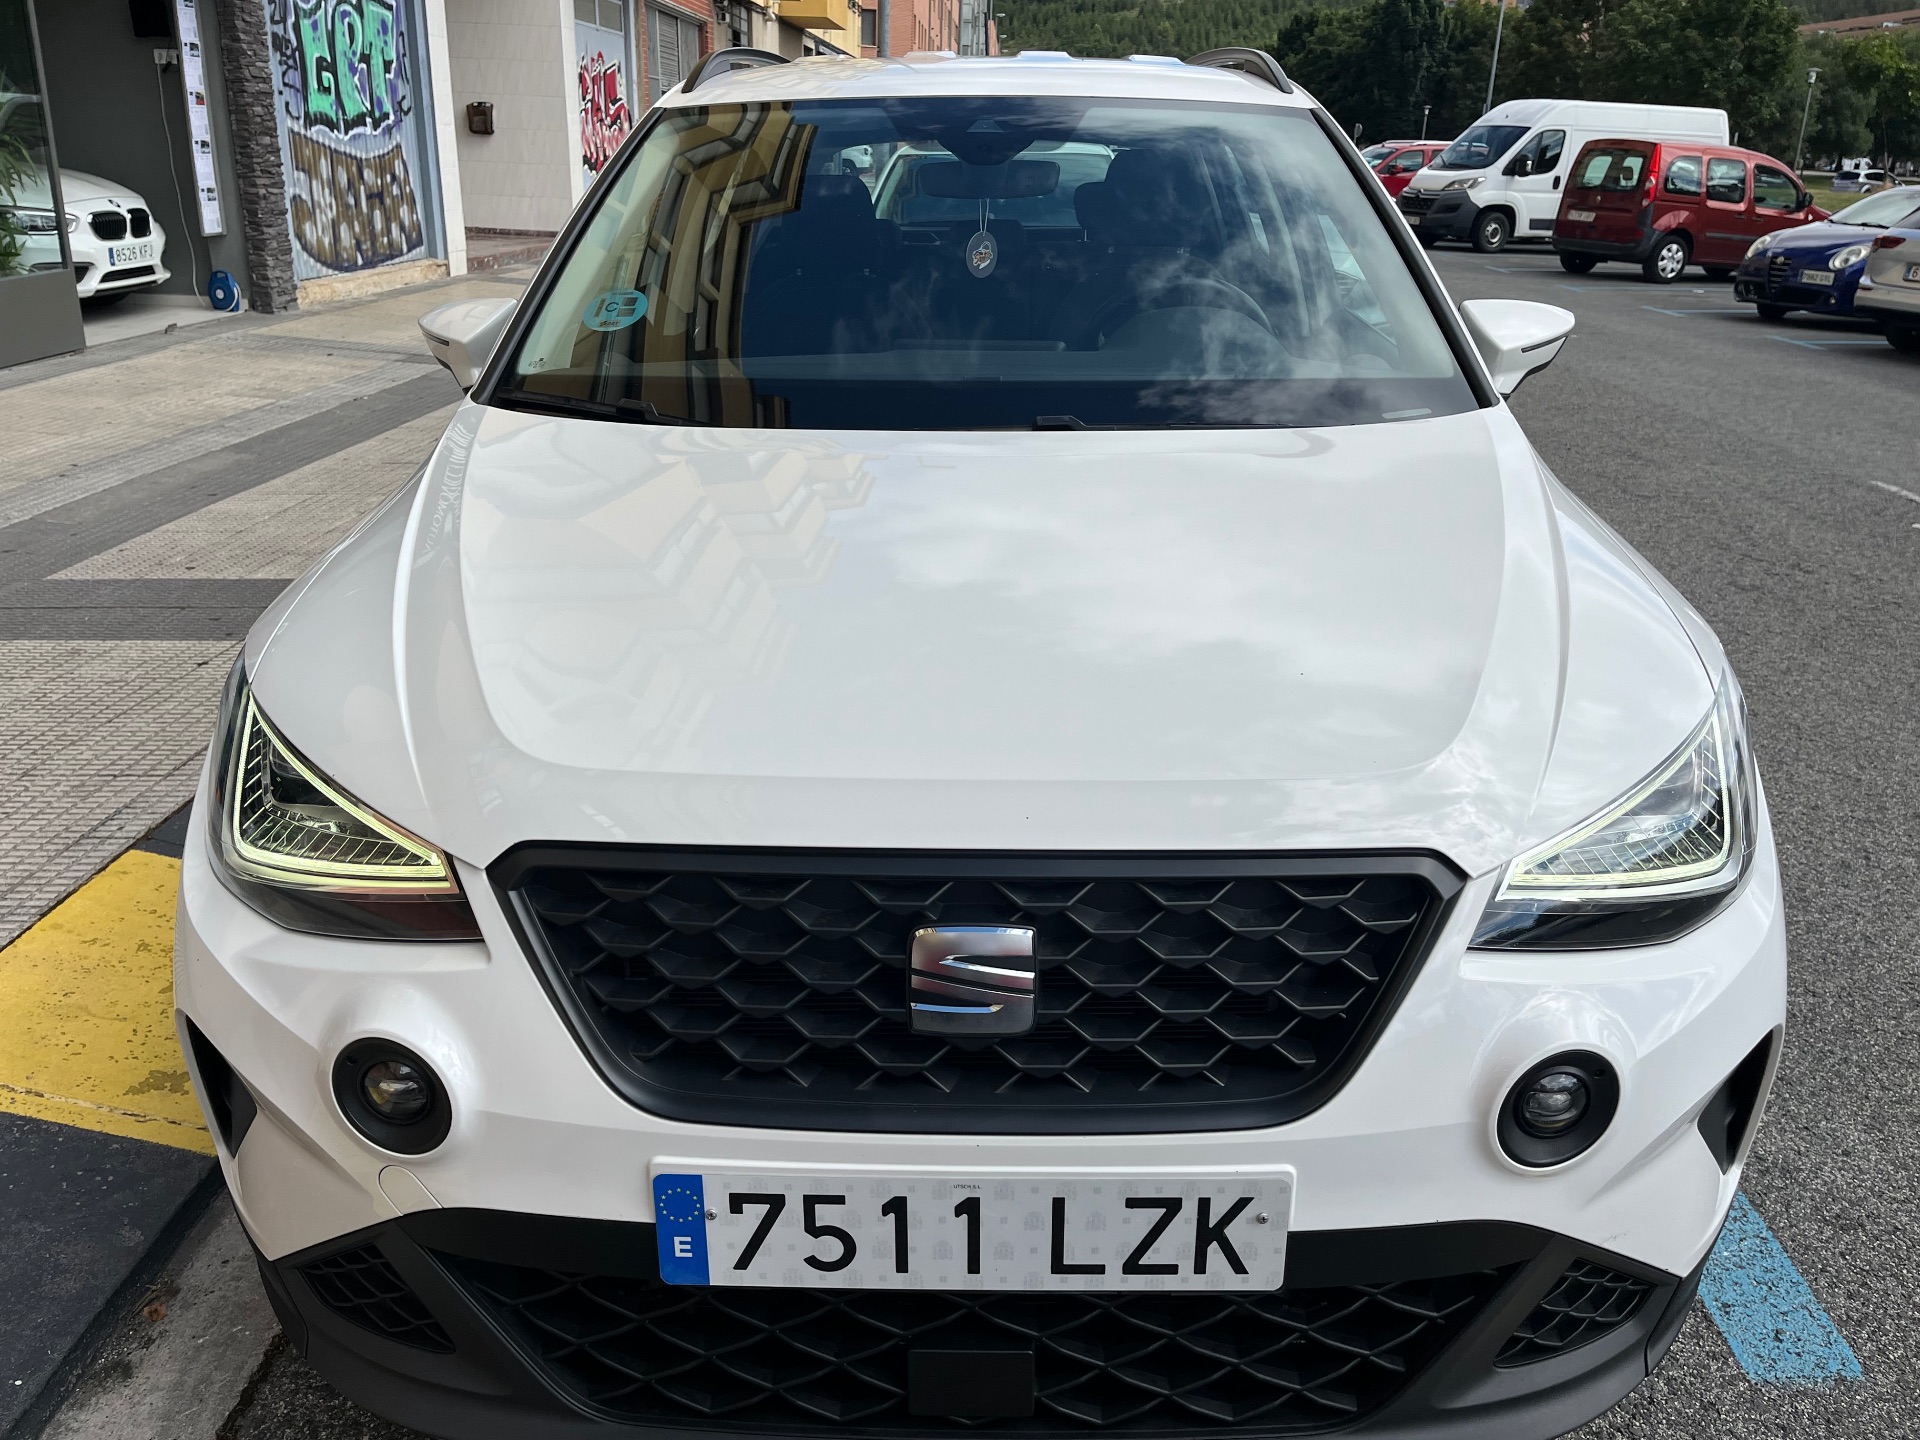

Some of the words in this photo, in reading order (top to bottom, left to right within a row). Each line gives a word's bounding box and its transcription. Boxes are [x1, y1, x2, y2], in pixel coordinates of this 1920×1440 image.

[115, 247, 137, 262] 8526
[729, 1193, 981, 1274] 7511
[1051, 1197, 1255, 1276] LZK
[673, 1236, 693, 1258] E
